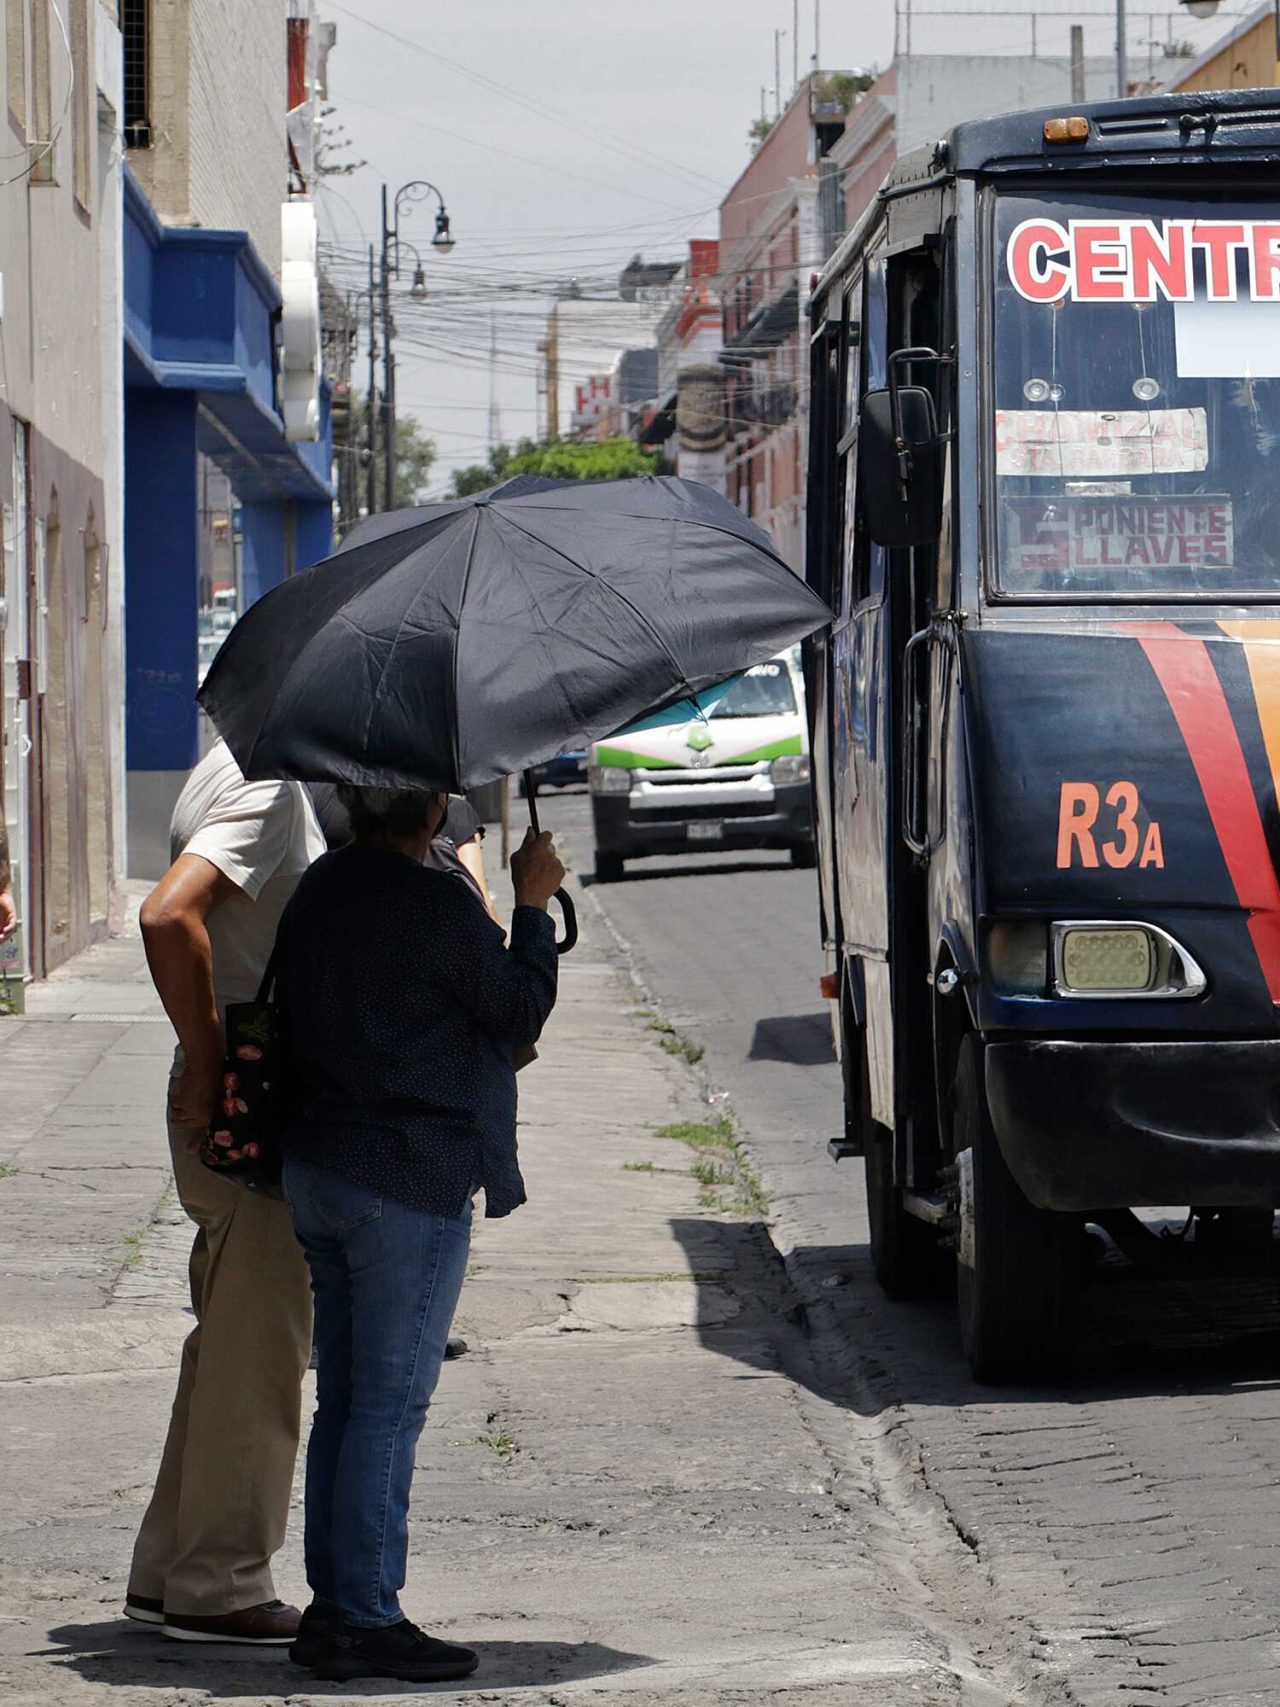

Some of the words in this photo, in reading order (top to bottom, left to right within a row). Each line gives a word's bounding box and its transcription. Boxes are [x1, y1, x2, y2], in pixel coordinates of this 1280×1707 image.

[1071, 505, 1227, 536] PONIENTE
[1073, 535, 1228, 566] LLAVES
[1056, 780, 1165, 869] R3A
